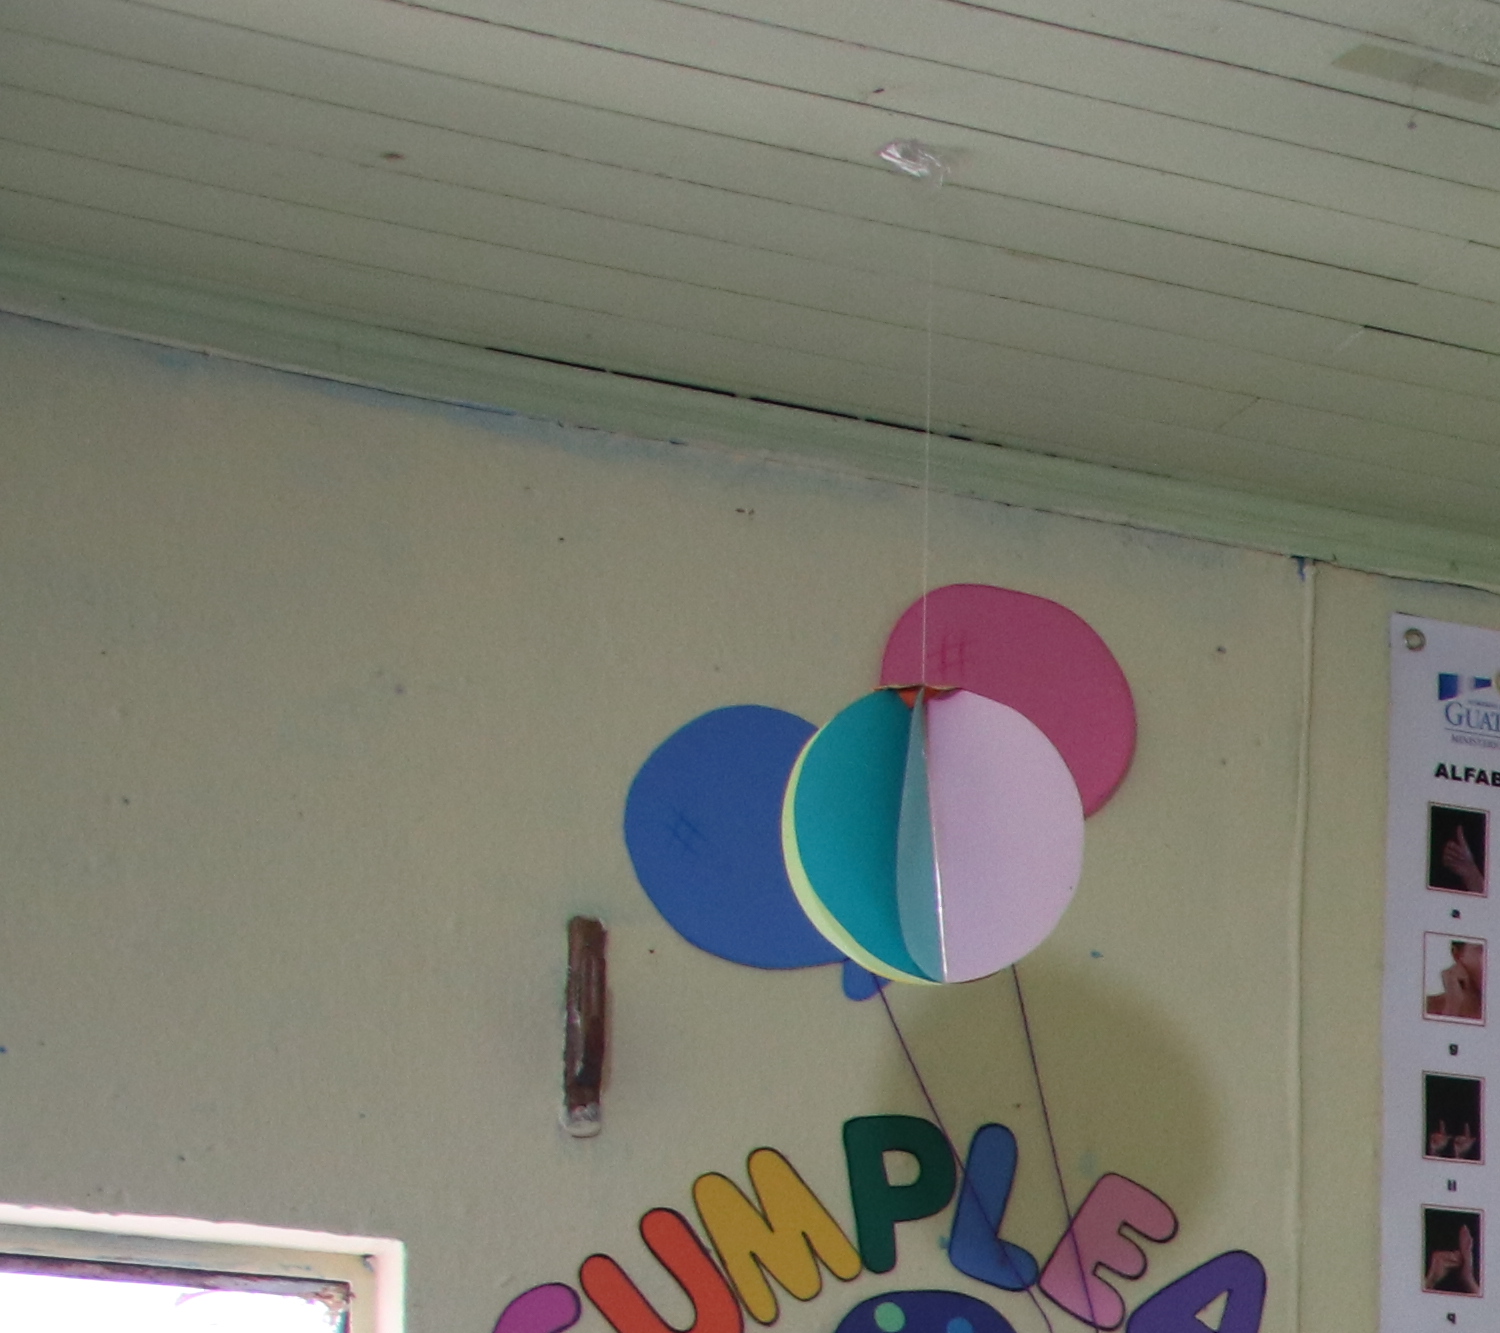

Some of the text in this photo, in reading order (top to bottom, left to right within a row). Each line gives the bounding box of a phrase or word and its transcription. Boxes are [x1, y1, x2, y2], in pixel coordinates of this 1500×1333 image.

[1451, 909, 1460, 918] a
[1449, 1044, 1458, 1056] g
[1447, 1180, 1457, 1191] ll
[1447, 1313, 1456, 1324] q
